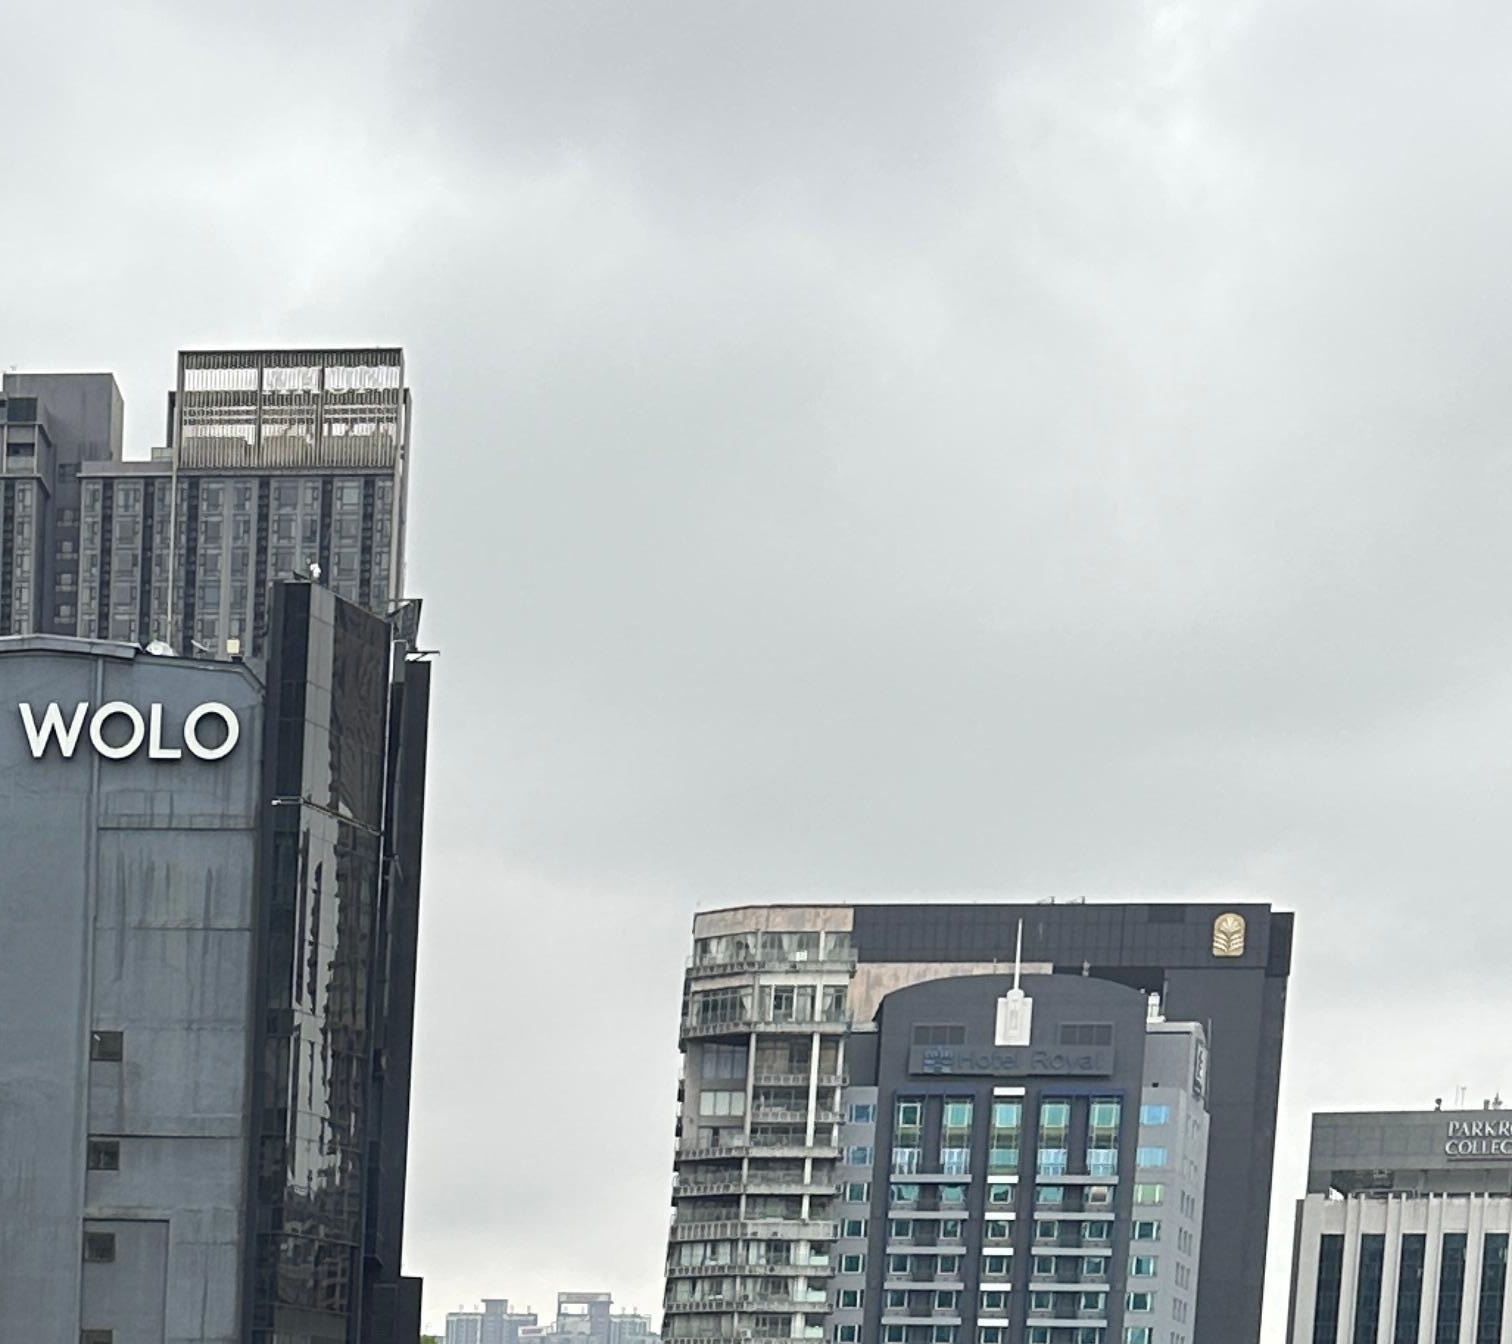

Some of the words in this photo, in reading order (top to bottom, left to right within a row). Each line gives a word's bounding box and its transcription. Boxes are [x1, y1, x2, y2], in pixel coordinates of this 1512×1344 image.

[18, 701, 240, 761] WOLO
[957, 1050, 1018, 1071] Hotel
[1031, 1049, 1102, 1075] Royal
[1448, 1120, 1512, 1137] PARKR
